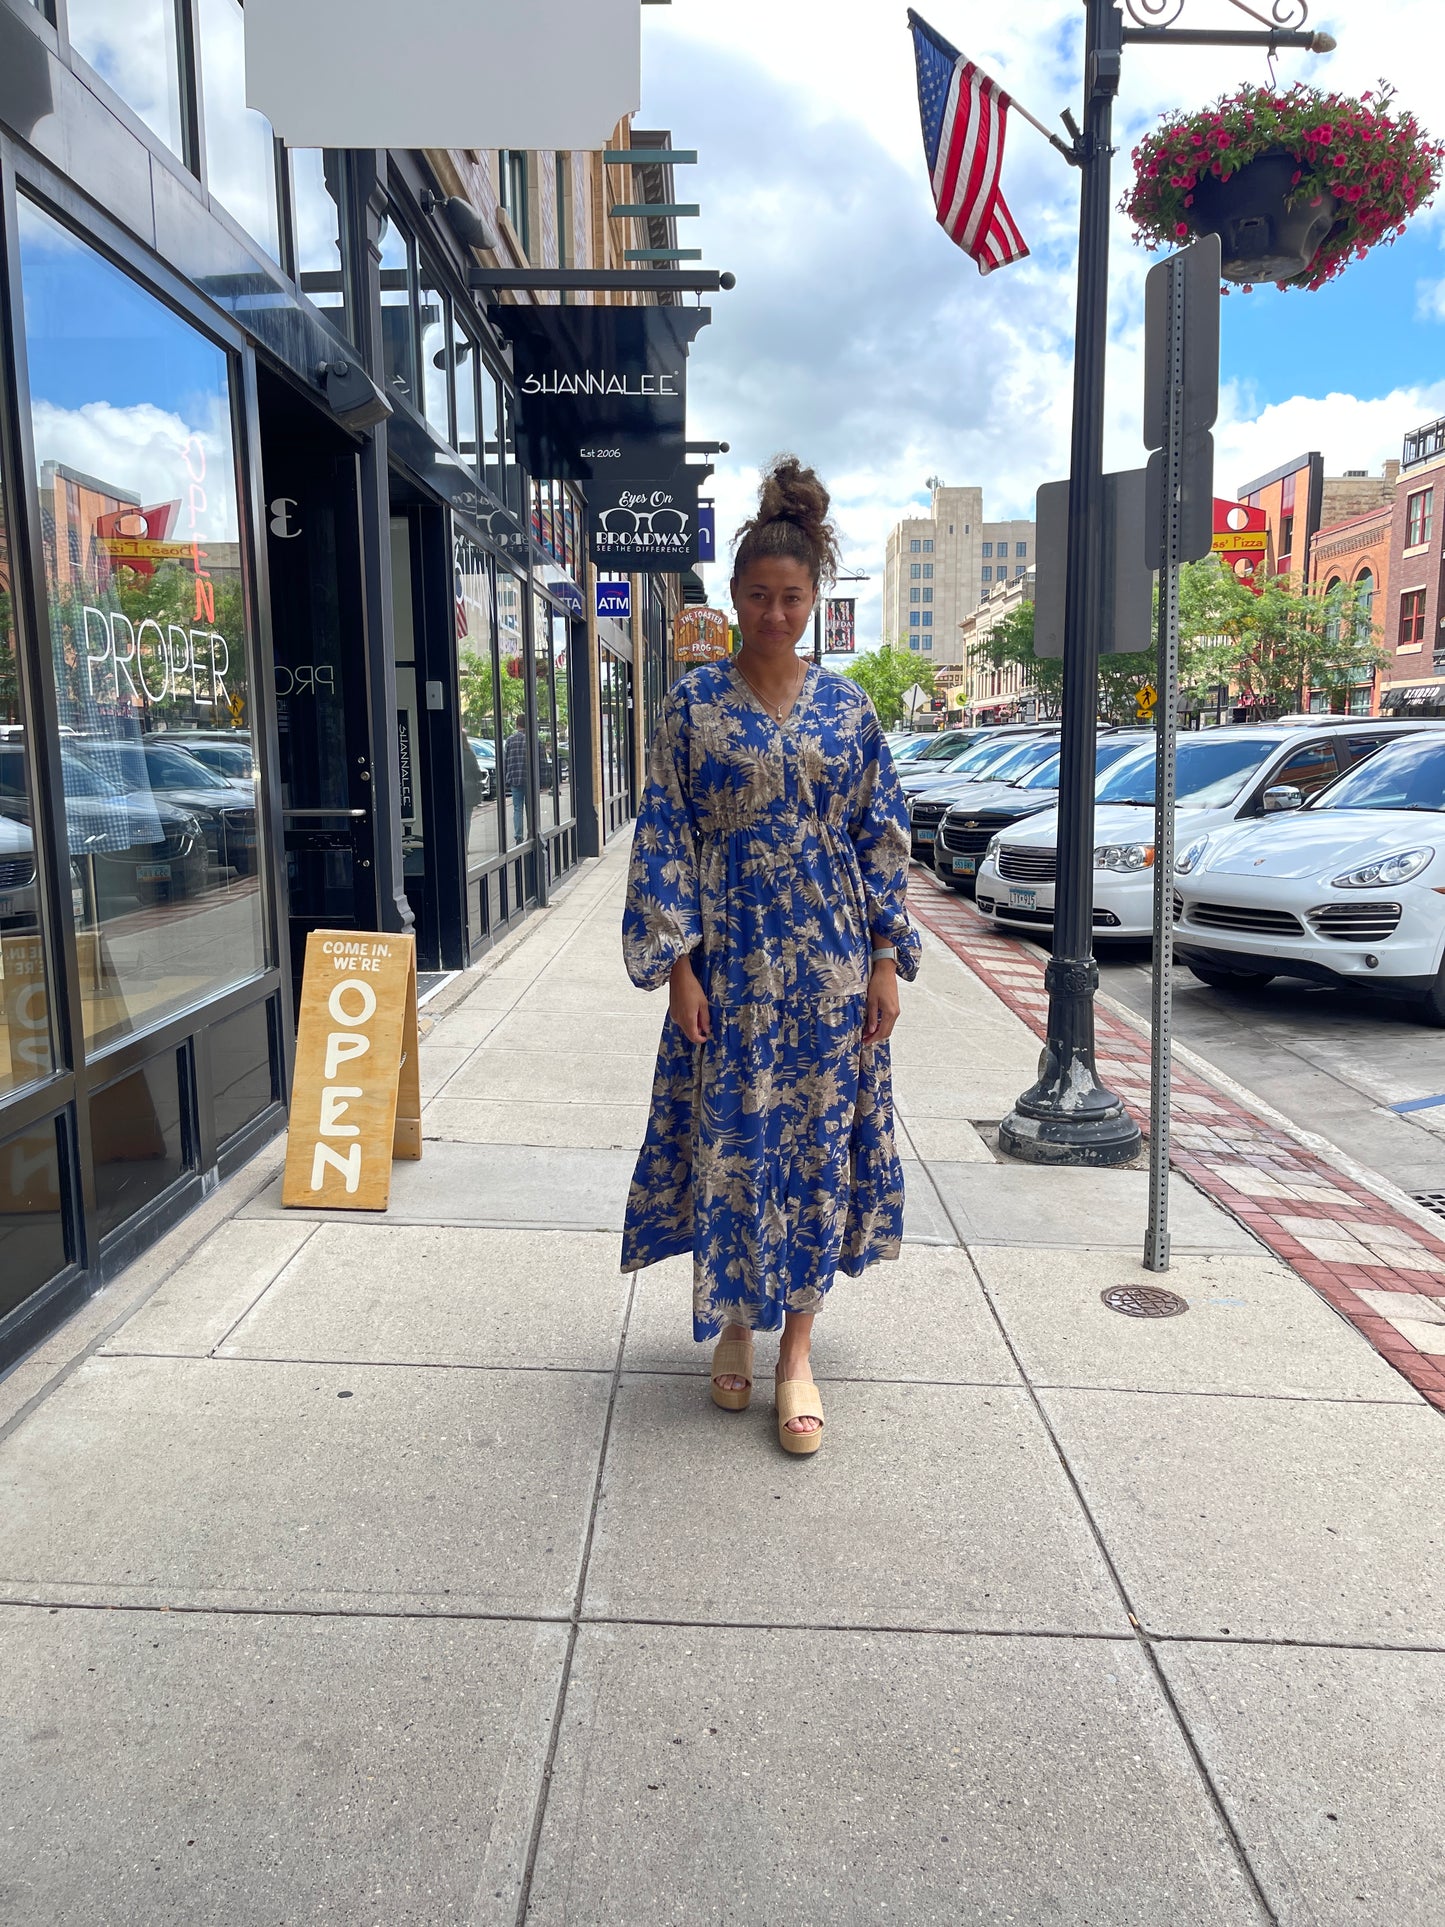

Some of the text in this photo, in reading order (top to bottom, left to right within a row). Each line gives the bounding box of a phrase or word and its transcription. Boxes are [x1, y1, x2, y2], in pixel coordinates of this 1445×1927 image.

[521, 369, 679, 396] SHANNALEE
[580, 448, 621, 458] Est 2006
[618, 490, 674, 508] Eyes On
[596, 531, 692, 546] BROADWAY
[1233, 536, 1263, 548] Pizza
[596, 545, 691, 553] SEE THE DIFFERENCE
[598, 597, 629, 610] ATM
[680, 610, 723, 625] THE TOASTED
[692, 643, 712, 652] FROG
[83, 605, 232, 706] PROPER
[322, 941, 392, 958] COME IN.
[333, 956, 382, 972] WE'RE
[310, 978, 377, 1194] OPEN
